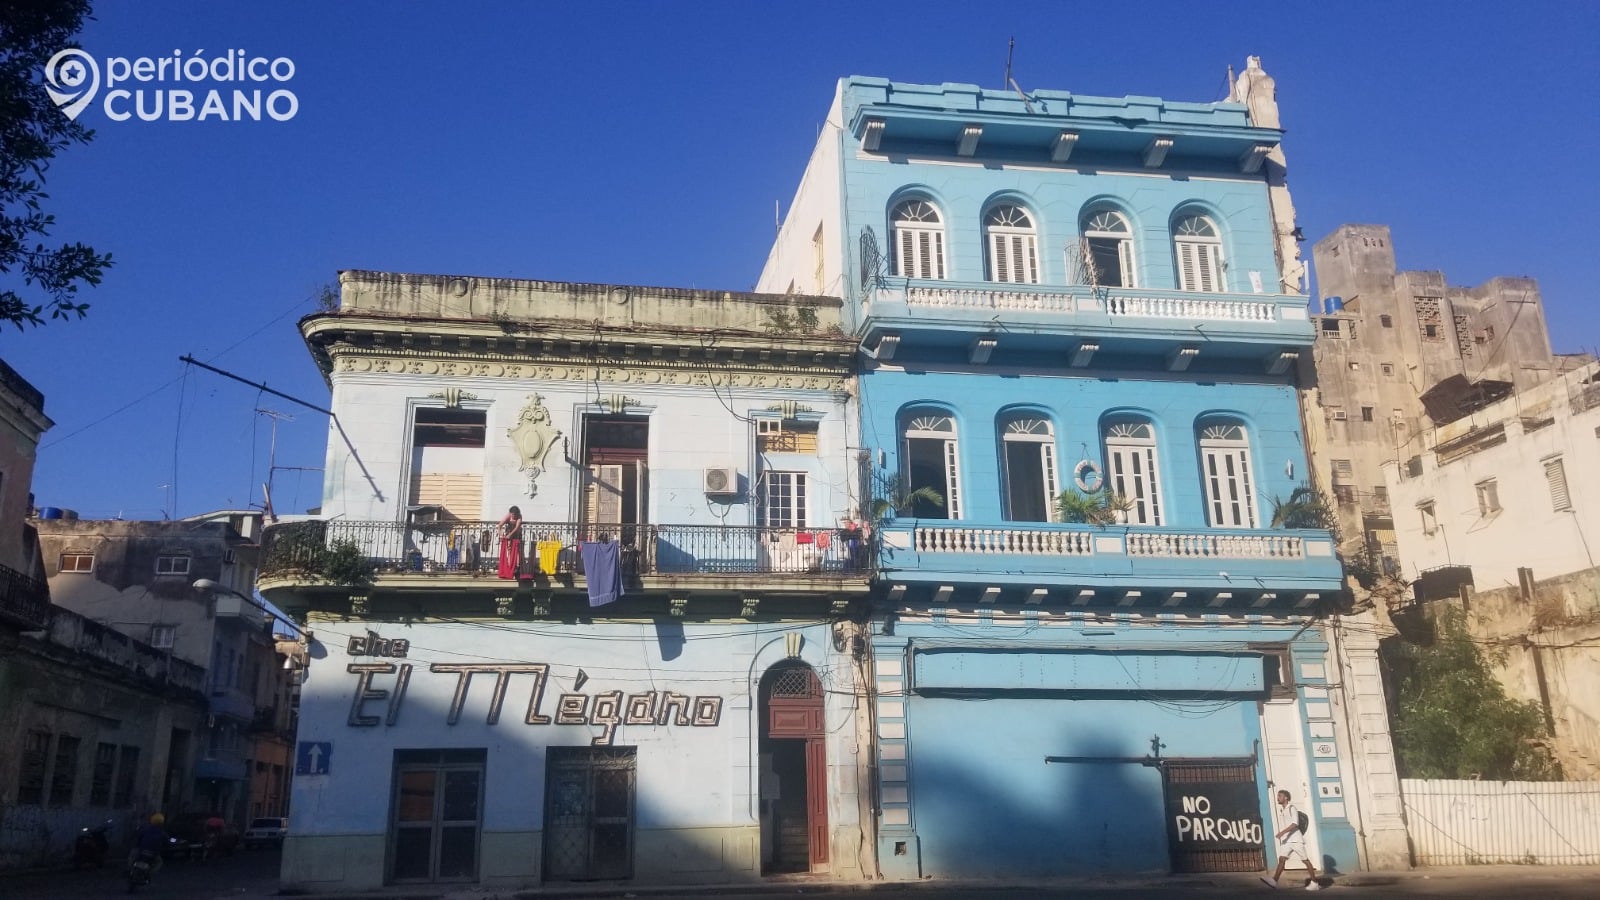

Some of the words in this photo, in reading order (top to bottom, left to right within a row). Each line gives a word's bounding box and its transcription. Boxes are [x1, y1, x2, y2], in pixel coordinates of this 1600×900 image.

[347, 663, 413, 727] El
[429, 663, 723, 746] Mégano
[1182, 795, 1210, 815] NO
[1177, 815, 1262, 845] PARQUEO
